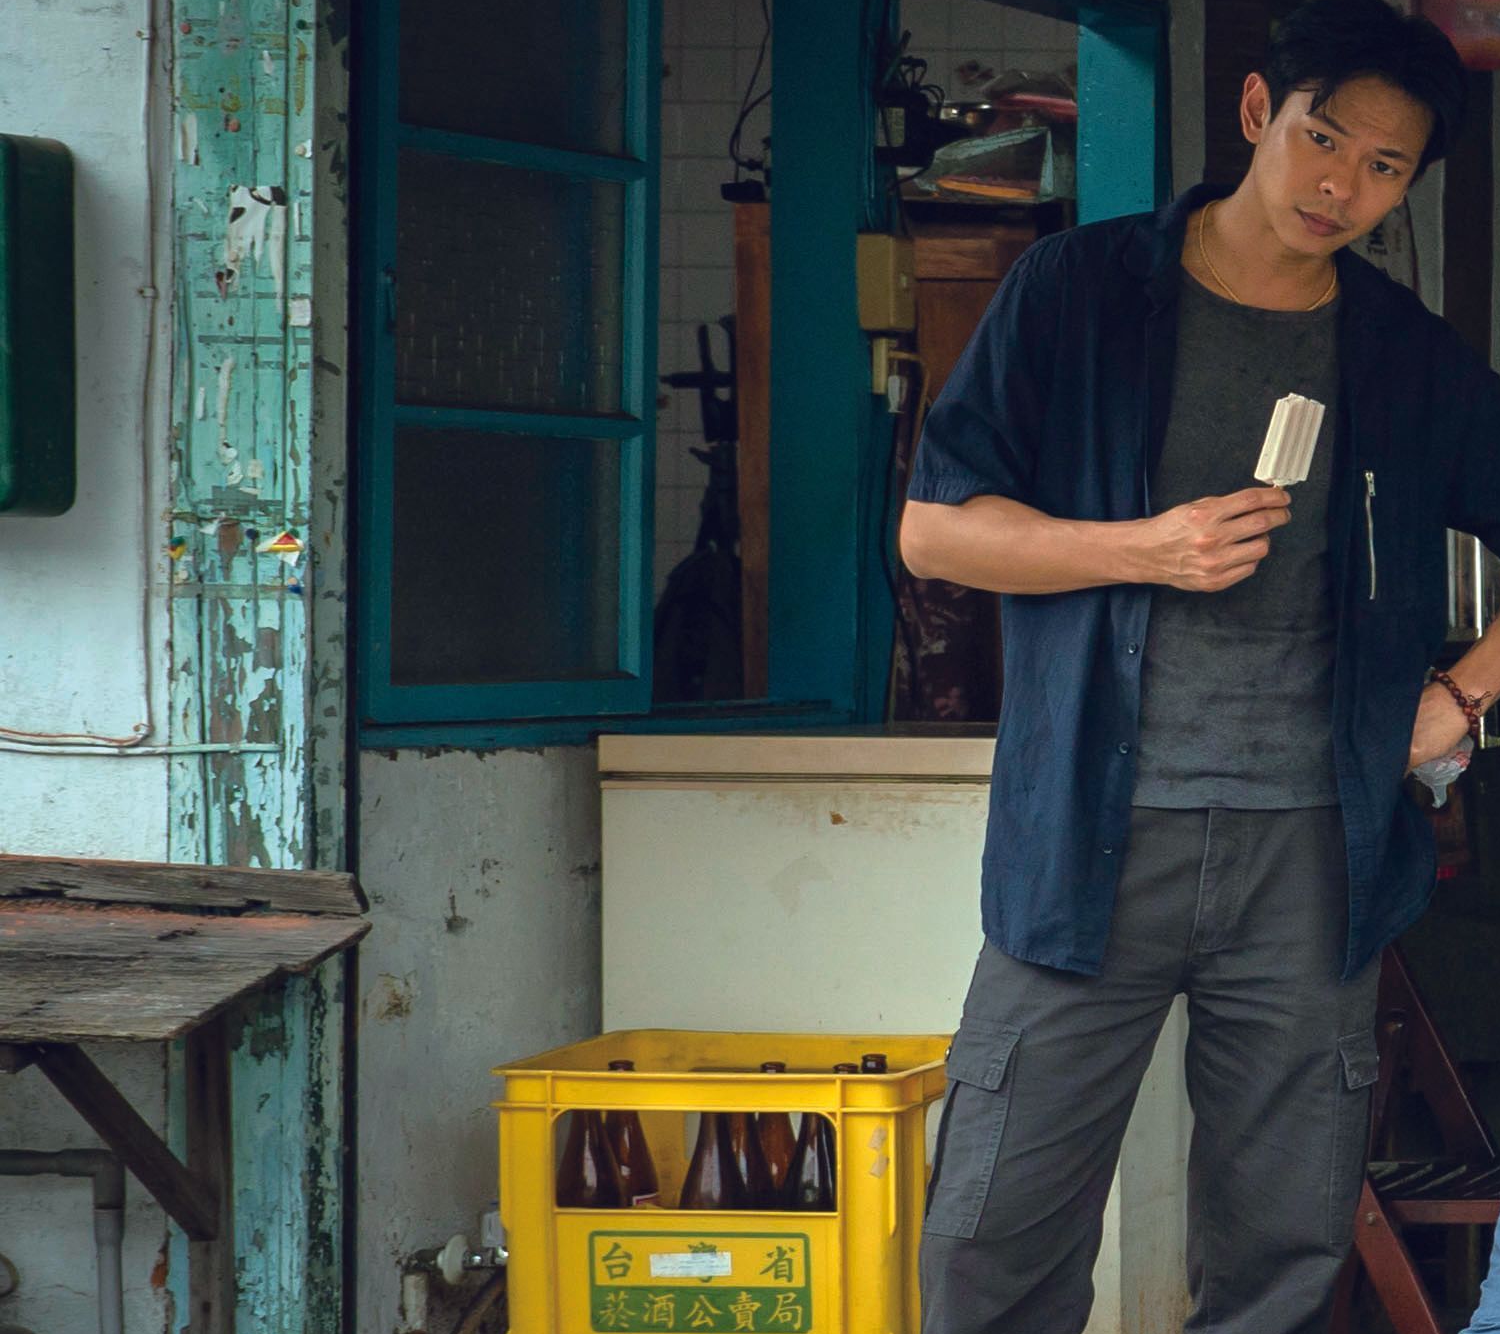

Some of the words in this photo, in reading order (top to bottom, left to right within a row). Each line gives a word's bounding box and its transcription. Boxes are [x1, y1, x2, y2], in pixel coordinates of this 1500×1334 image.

[599, 1290, 803, 1331] 菸酒公賣局
